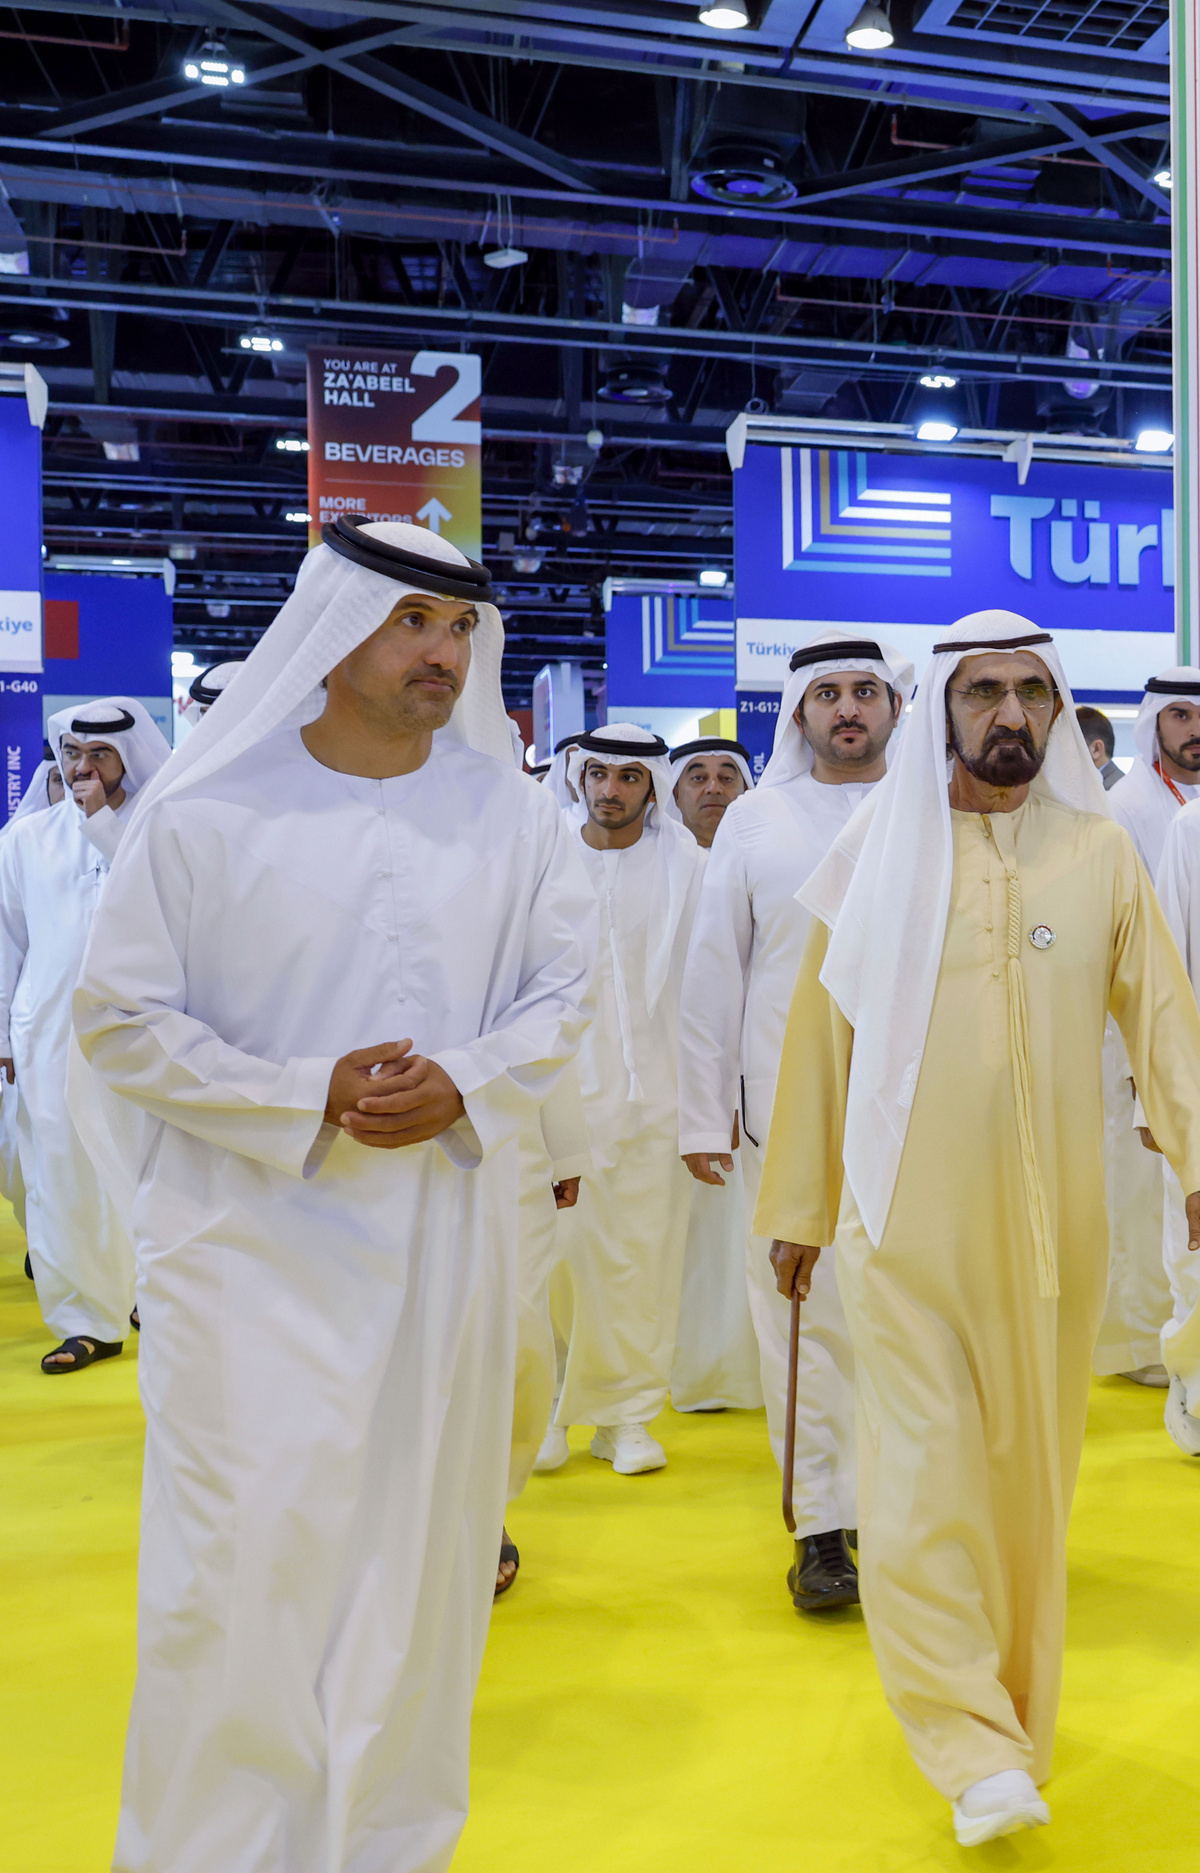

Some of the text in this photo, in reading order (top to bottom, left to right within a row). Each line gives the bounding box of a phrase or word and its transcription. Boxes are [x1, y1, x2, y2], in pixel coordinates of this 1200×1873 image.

[323, 358, 398, 374] YOU ARE AT
[323, 350, 482, 445] ZA'ABEEL 2
[323, 389, 375, 408] HALL
[324, 442, 465, 468] BEVERAGES
[319, 496, 368, 511] MORE
[7, 745, 21, 770] INC
[754, 751, 765, 774] OIL
